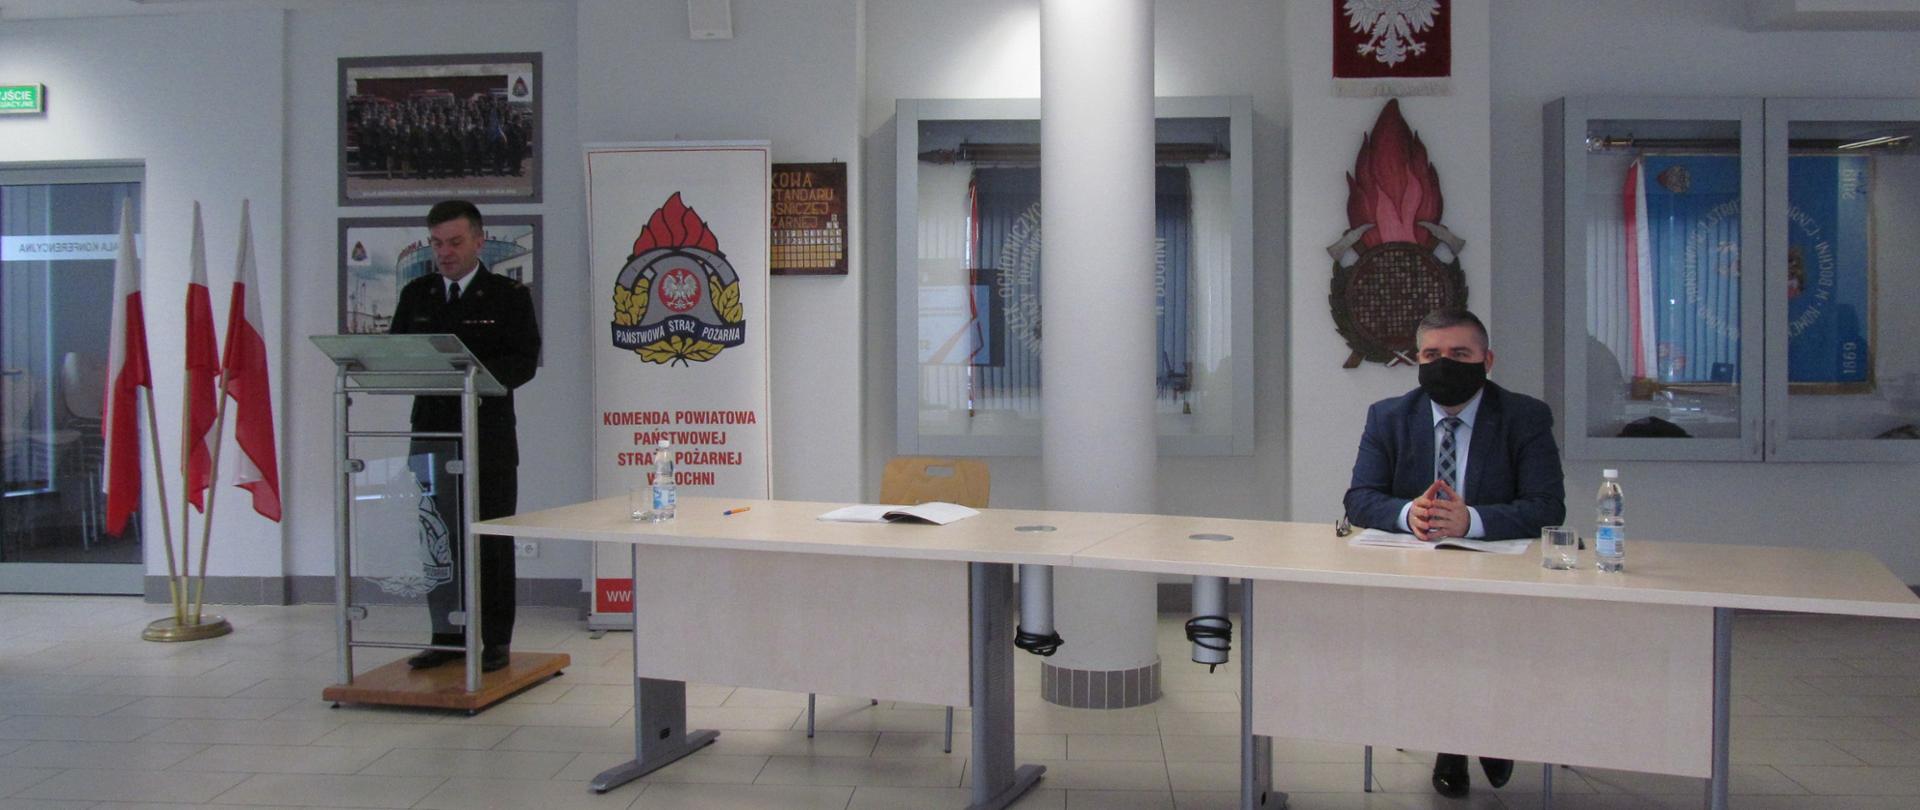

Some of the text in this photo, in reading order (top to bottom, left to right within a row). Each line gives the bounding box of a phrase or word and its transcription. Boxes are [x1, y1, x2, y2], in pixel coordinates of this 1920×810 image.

[772, 188, 834, 202] TANDARU
[616, 326, 666, 344] PAŃSTWOWA
[668, 319, 696, 333] STRAŻ
[1843, 342, 1857, 375] 1869
[603, 411, 757, 426] KOMENDA POWIATOWA
[634, 428, 727, 446] PAŃSTWOWEJ
[675, 447, 742, 466] POŻARNEJ
[674, 471, 716, 486] OCHNI
